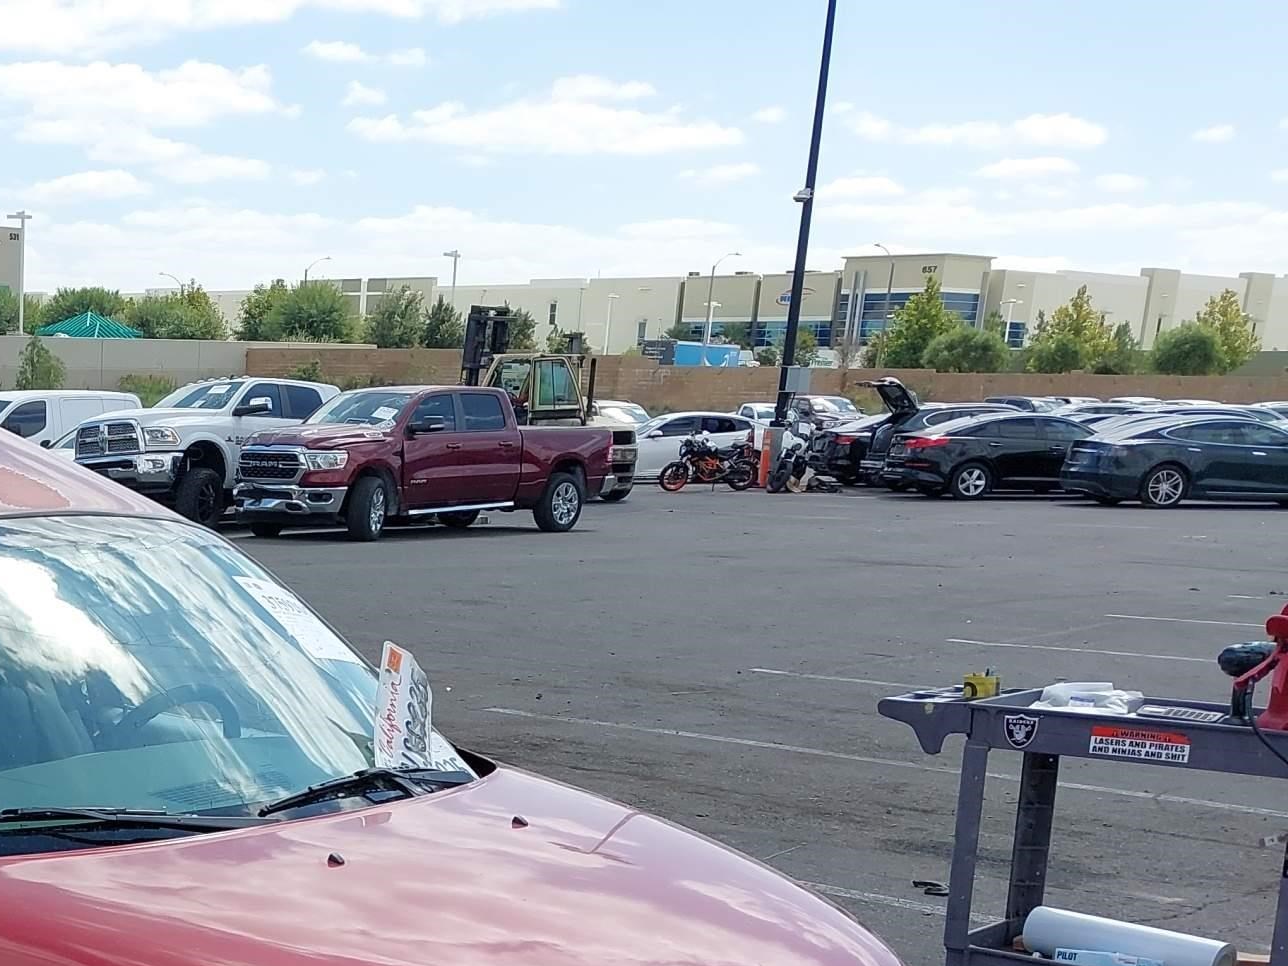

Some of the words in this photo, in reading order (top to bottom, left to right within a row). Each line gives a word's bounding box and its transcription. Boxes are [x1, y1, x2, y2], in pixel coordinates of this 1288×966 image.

[922, 265, 938, 274] 657
[251, 460, 278, 468] RAM
[379, 674, 403, 759] California
[1094, 737, 1126, 747] LASERS
[1128, 739, 1147, 749] AND
[1149, 742, 1186, 753] PIRATES
[1092, 745, 1110, 754] AND
[1144, 749, 1162, 759] AND
[1165, 752, 1186, 762] SHIT
[1056, 950, 1079, 961] PILOT
